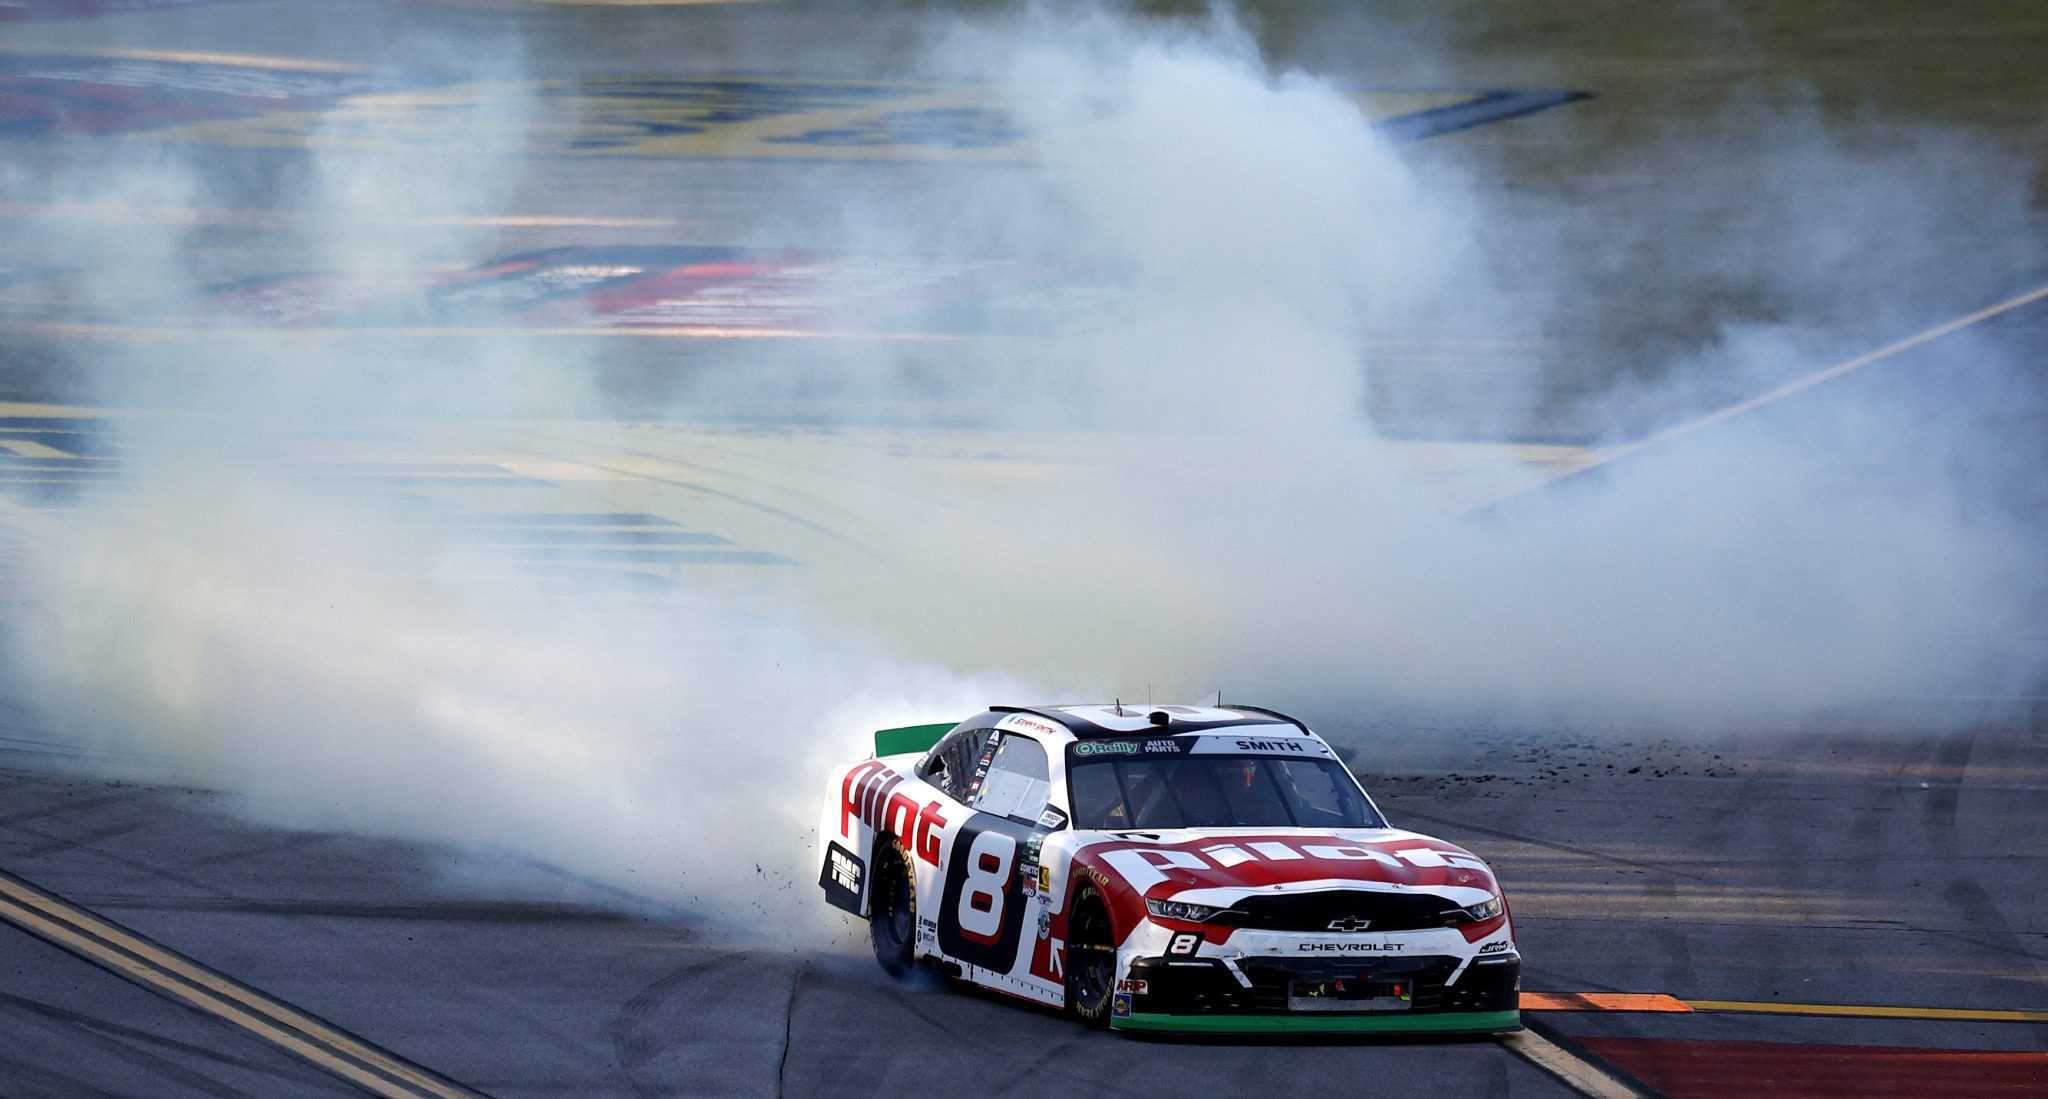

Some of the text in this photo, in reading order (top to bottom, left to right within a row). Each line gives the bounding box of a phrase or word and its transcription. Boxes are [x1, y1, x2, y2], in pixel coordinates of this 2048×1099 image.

[1075, 741, 1139, 756] O'Reilly
[1236, 740, 1304, 752] SMITH
[1072, 865, 1109, 887] GOODYEAR
[958, 831, 1016, 940] 8
[1170, 934, 1198, 955] 8
[1299, 943, 1405, 951] CHEVROLET
[1481, 943, 1508, 953] JRM
[1116, 979, 1147, 993] ARP
